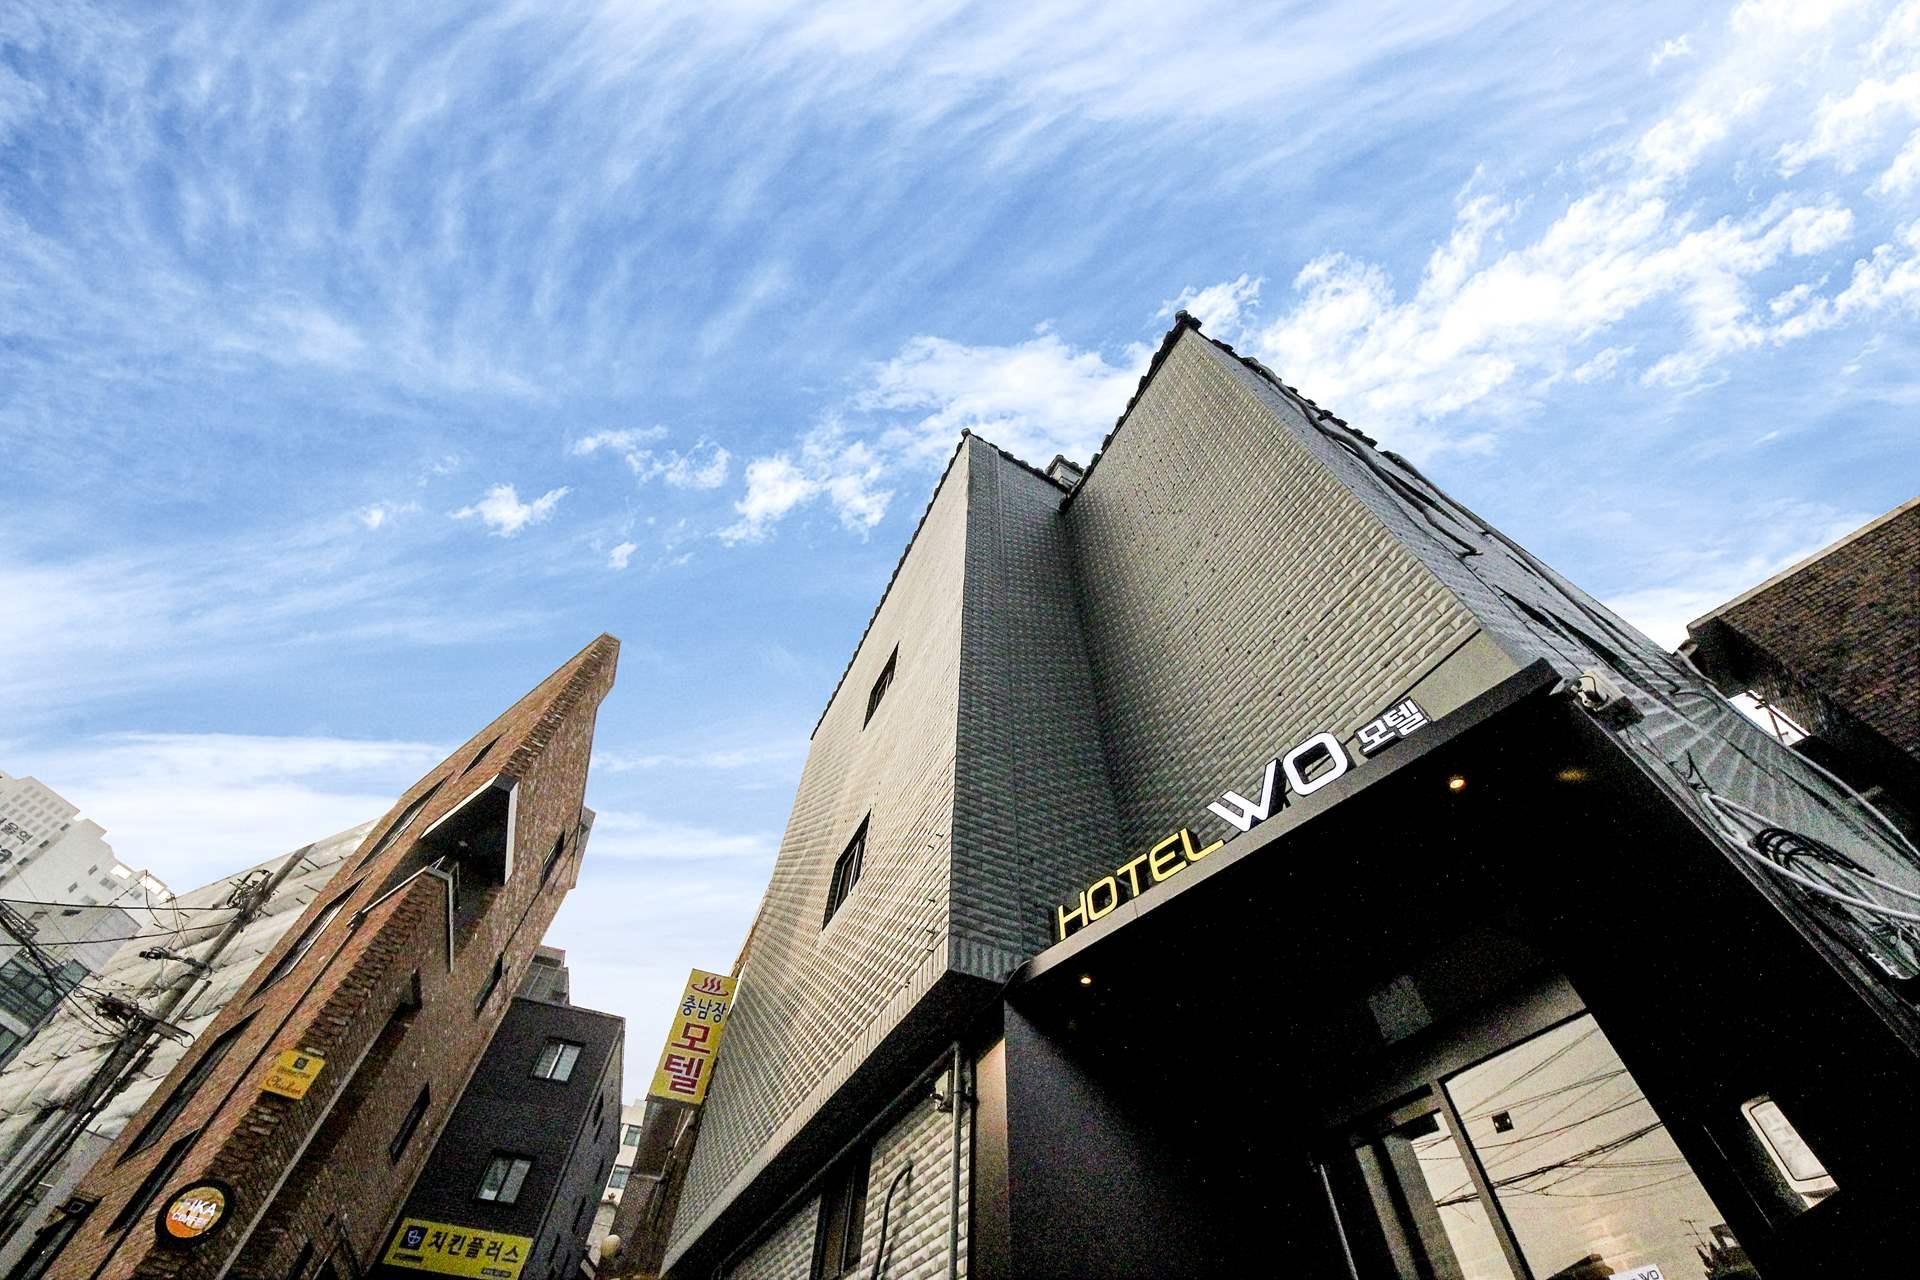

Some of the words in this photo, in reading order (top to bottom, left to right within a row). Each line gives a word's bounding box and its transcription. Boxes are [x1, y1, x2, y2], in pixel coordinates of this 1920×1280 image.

[1057, 827, 1225, 940] HOTEL
[1206, 732, 1349, 832] WO
[1357, 699, 1428, 753] 모텔
[682, 995, 726, 1023] 충남장
[664, 1022, 711, 1095] 모텔
[427, 1231, 519, 1263] 치킨플러스
